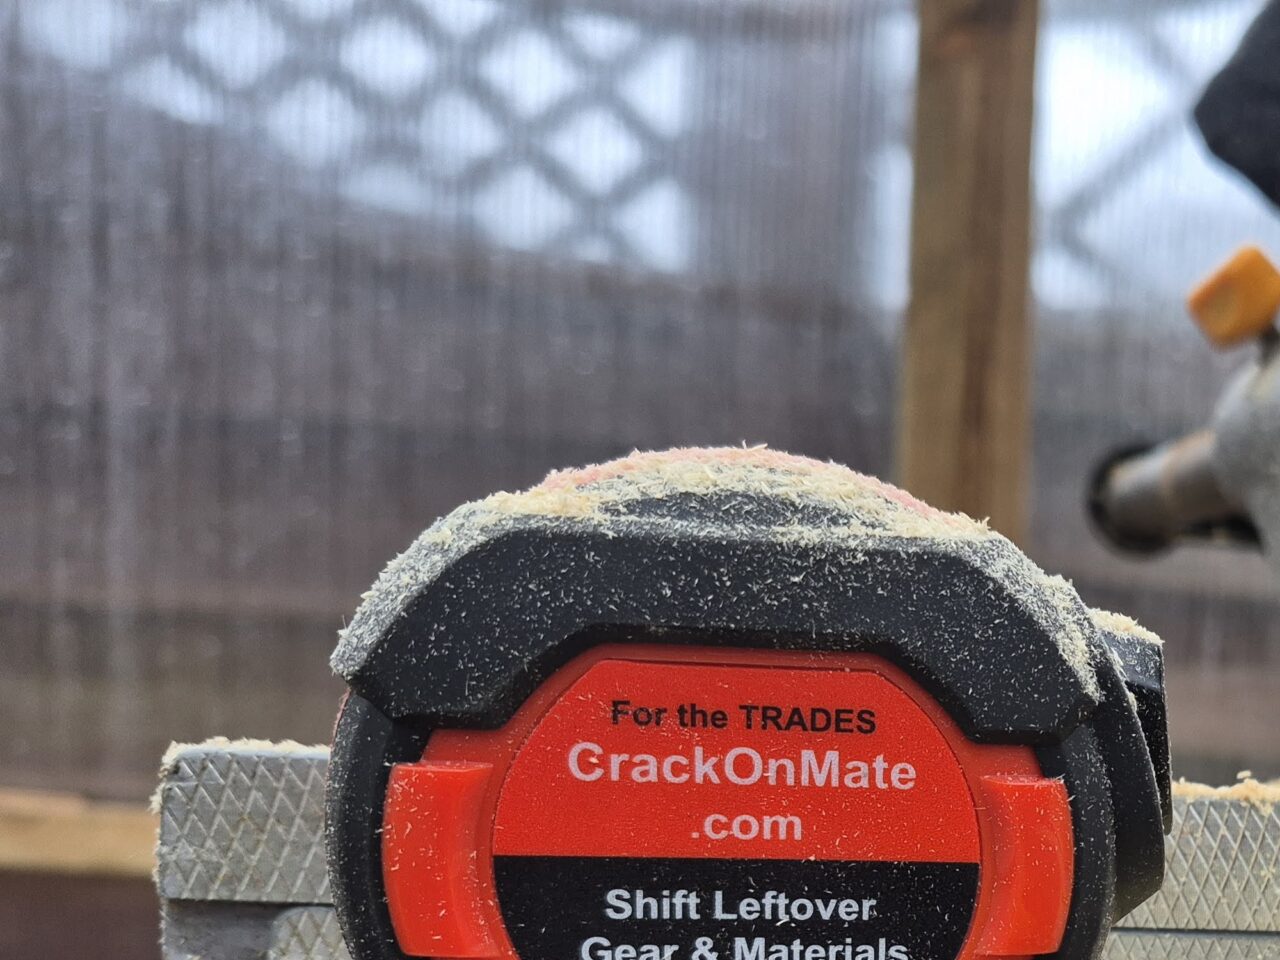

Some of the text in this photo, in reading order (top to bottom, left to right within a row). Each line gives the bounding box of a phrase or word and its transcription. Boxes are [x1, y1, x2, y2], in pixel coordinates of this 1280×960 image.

[611, 700, 876, 734] For the TRADES
[568, 742, 916, 790] CrackOnMate
[691, 813, 802, 841] .com
[605, 889, 877, 921] Shift Leftover
